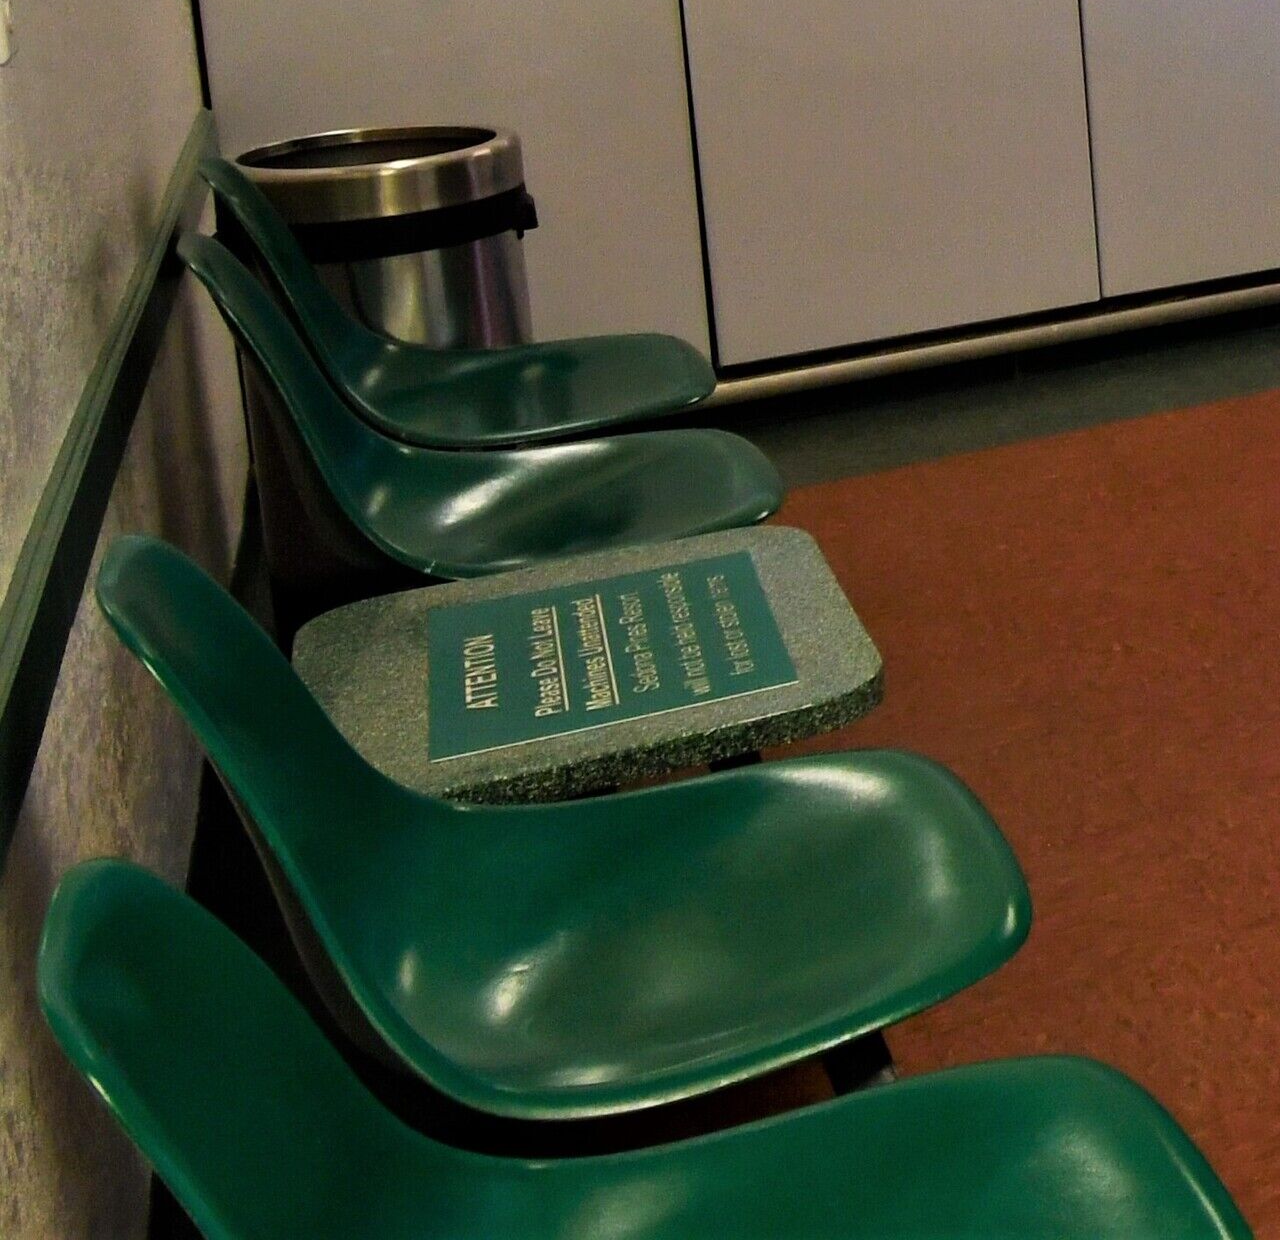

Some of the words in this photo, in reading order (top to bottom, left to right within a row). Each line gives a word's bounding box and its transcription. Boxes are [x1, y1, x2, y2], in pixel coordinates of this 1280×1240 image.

[530, 607, 553, 639] Leave
[531, 638, 555, 660] Not
[531, 659, 558, 678] Do
[464, 634, 497, 709] ATTENTION
[583, 656, 612, 710] Machines
[632, 651, 660, 693] Sedona
[535, 677, 562, 717] Please
